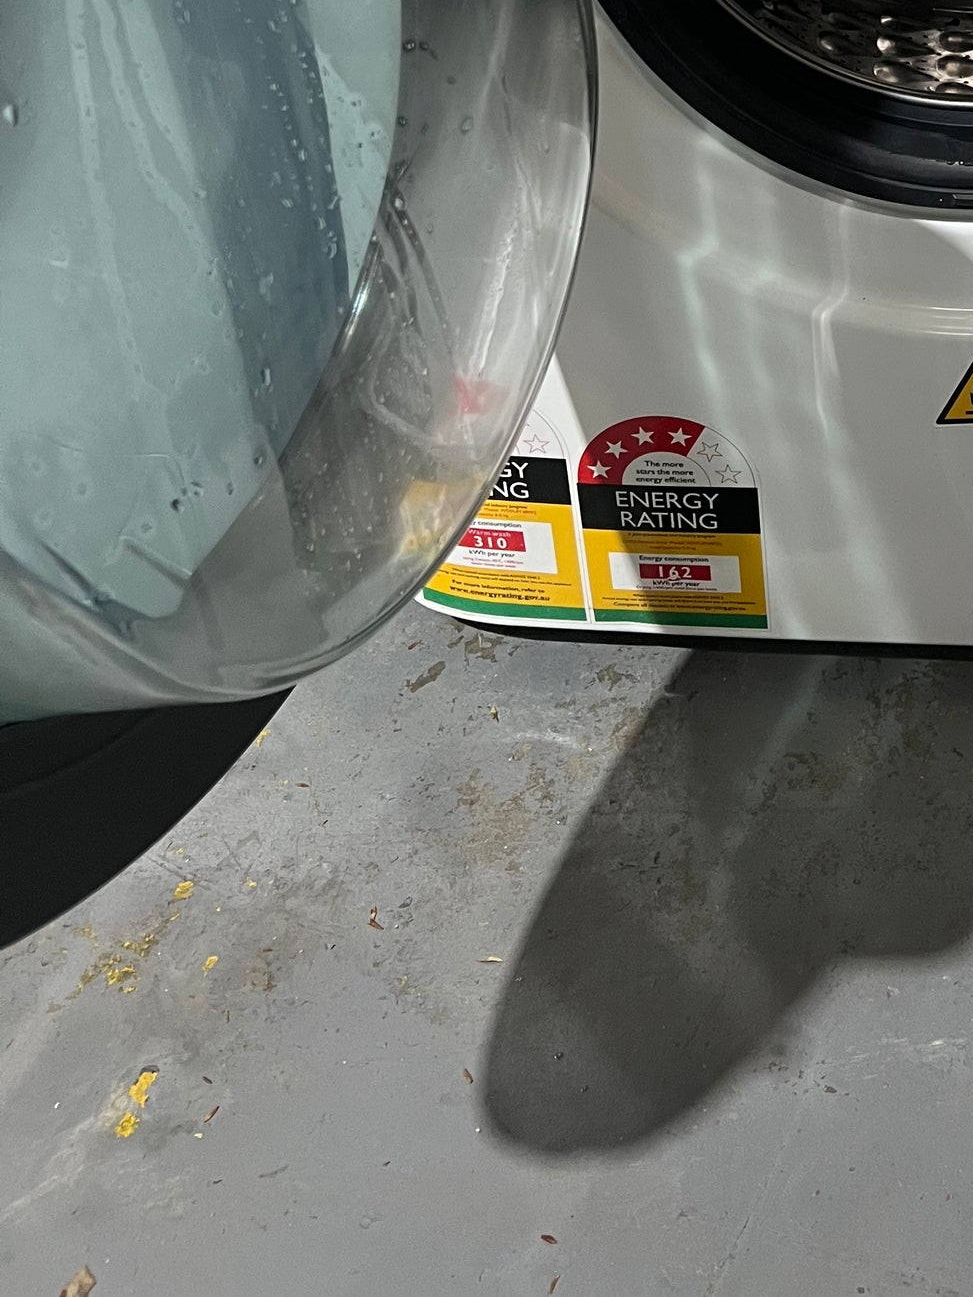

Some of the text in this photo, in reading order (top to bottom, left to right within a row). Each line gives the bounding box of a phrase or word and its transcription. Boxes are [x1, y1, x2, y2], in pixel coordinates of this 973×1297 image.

[644, 460, 661, 468] The
[635, 476, 696, 484] energy efficient
[615, 491, 719, 509] ENERGY
[620, 511, 718, 529] RATING
[477, 521, 522, 529] consumption
[474, 535, 507, 549] 310
[487, 550, 499, 558] per
[639, 555, 663, 563] Energy
[658, 566, 692, 580] 162
